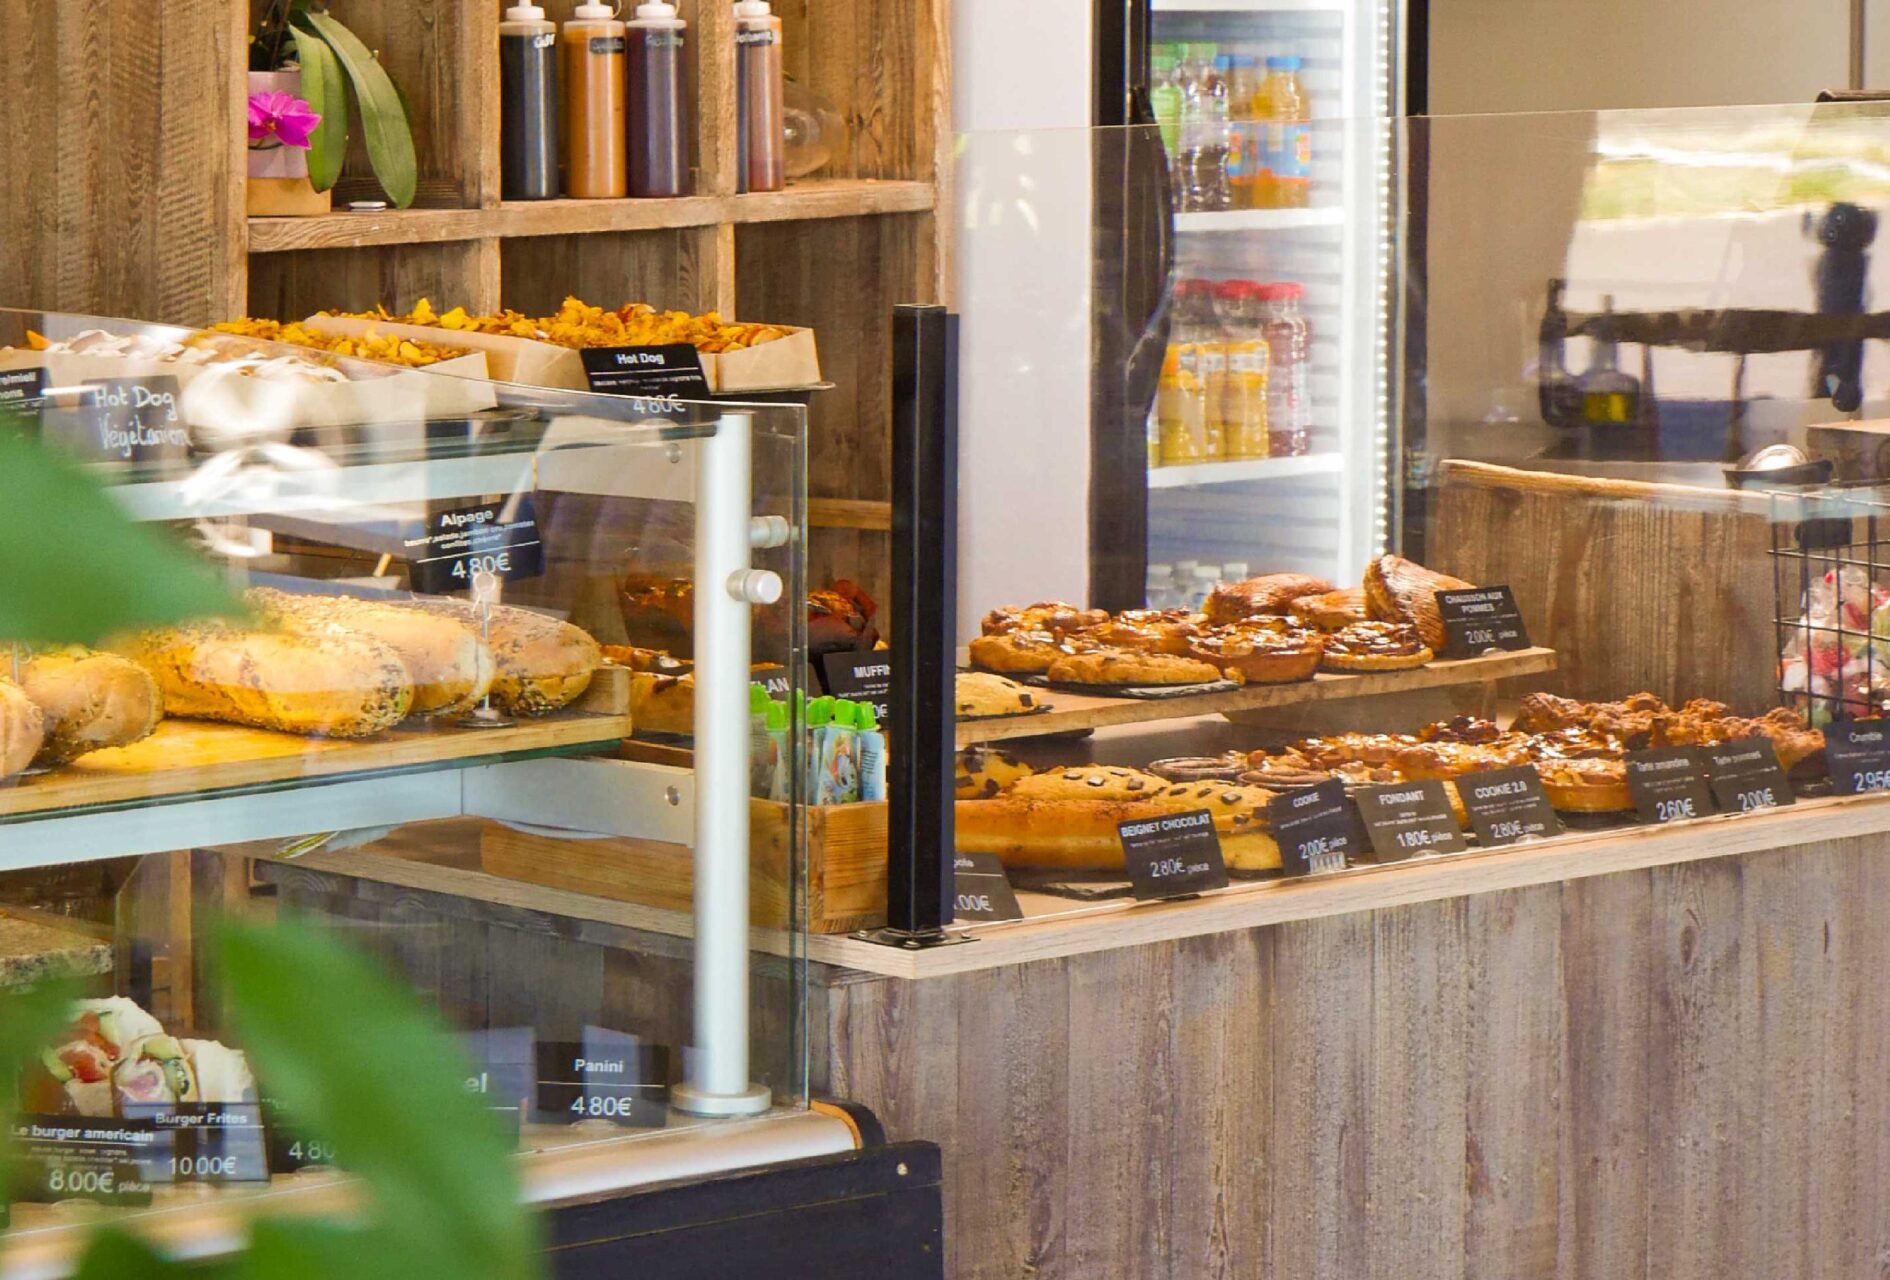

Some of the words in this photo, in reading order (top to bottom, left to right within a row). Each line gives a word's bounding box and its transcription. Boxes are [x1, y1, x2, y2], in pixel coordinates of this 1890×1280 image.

[617, 353, 638, 365] Hot
[639, 353, 665, 365] Dog
[94, 384, 128, 409] Hot
[131, 385, 178, 421] Dog
[441, 510, 494, 527] Alpage
[1379, 790, 1425, 805] FONDANT
[1474, 783, 1512, 799] COOKIE
[1120, 822, 1160, 837] BEIGNET
[1161, 813, 1210, 831] CHOCOLAT
[574, 1059, 624, 1074] Panini
[571, 1096, 632, 1117] 4.80€
[155, 1112, 204, 1128] Burger
[206, 1112, 248, 1125] Frites
[31, 1124, 80, 1140] burger
[83, 1128, 154, 1143] americain
[49, 1169, 115, 1194] 8.00€
